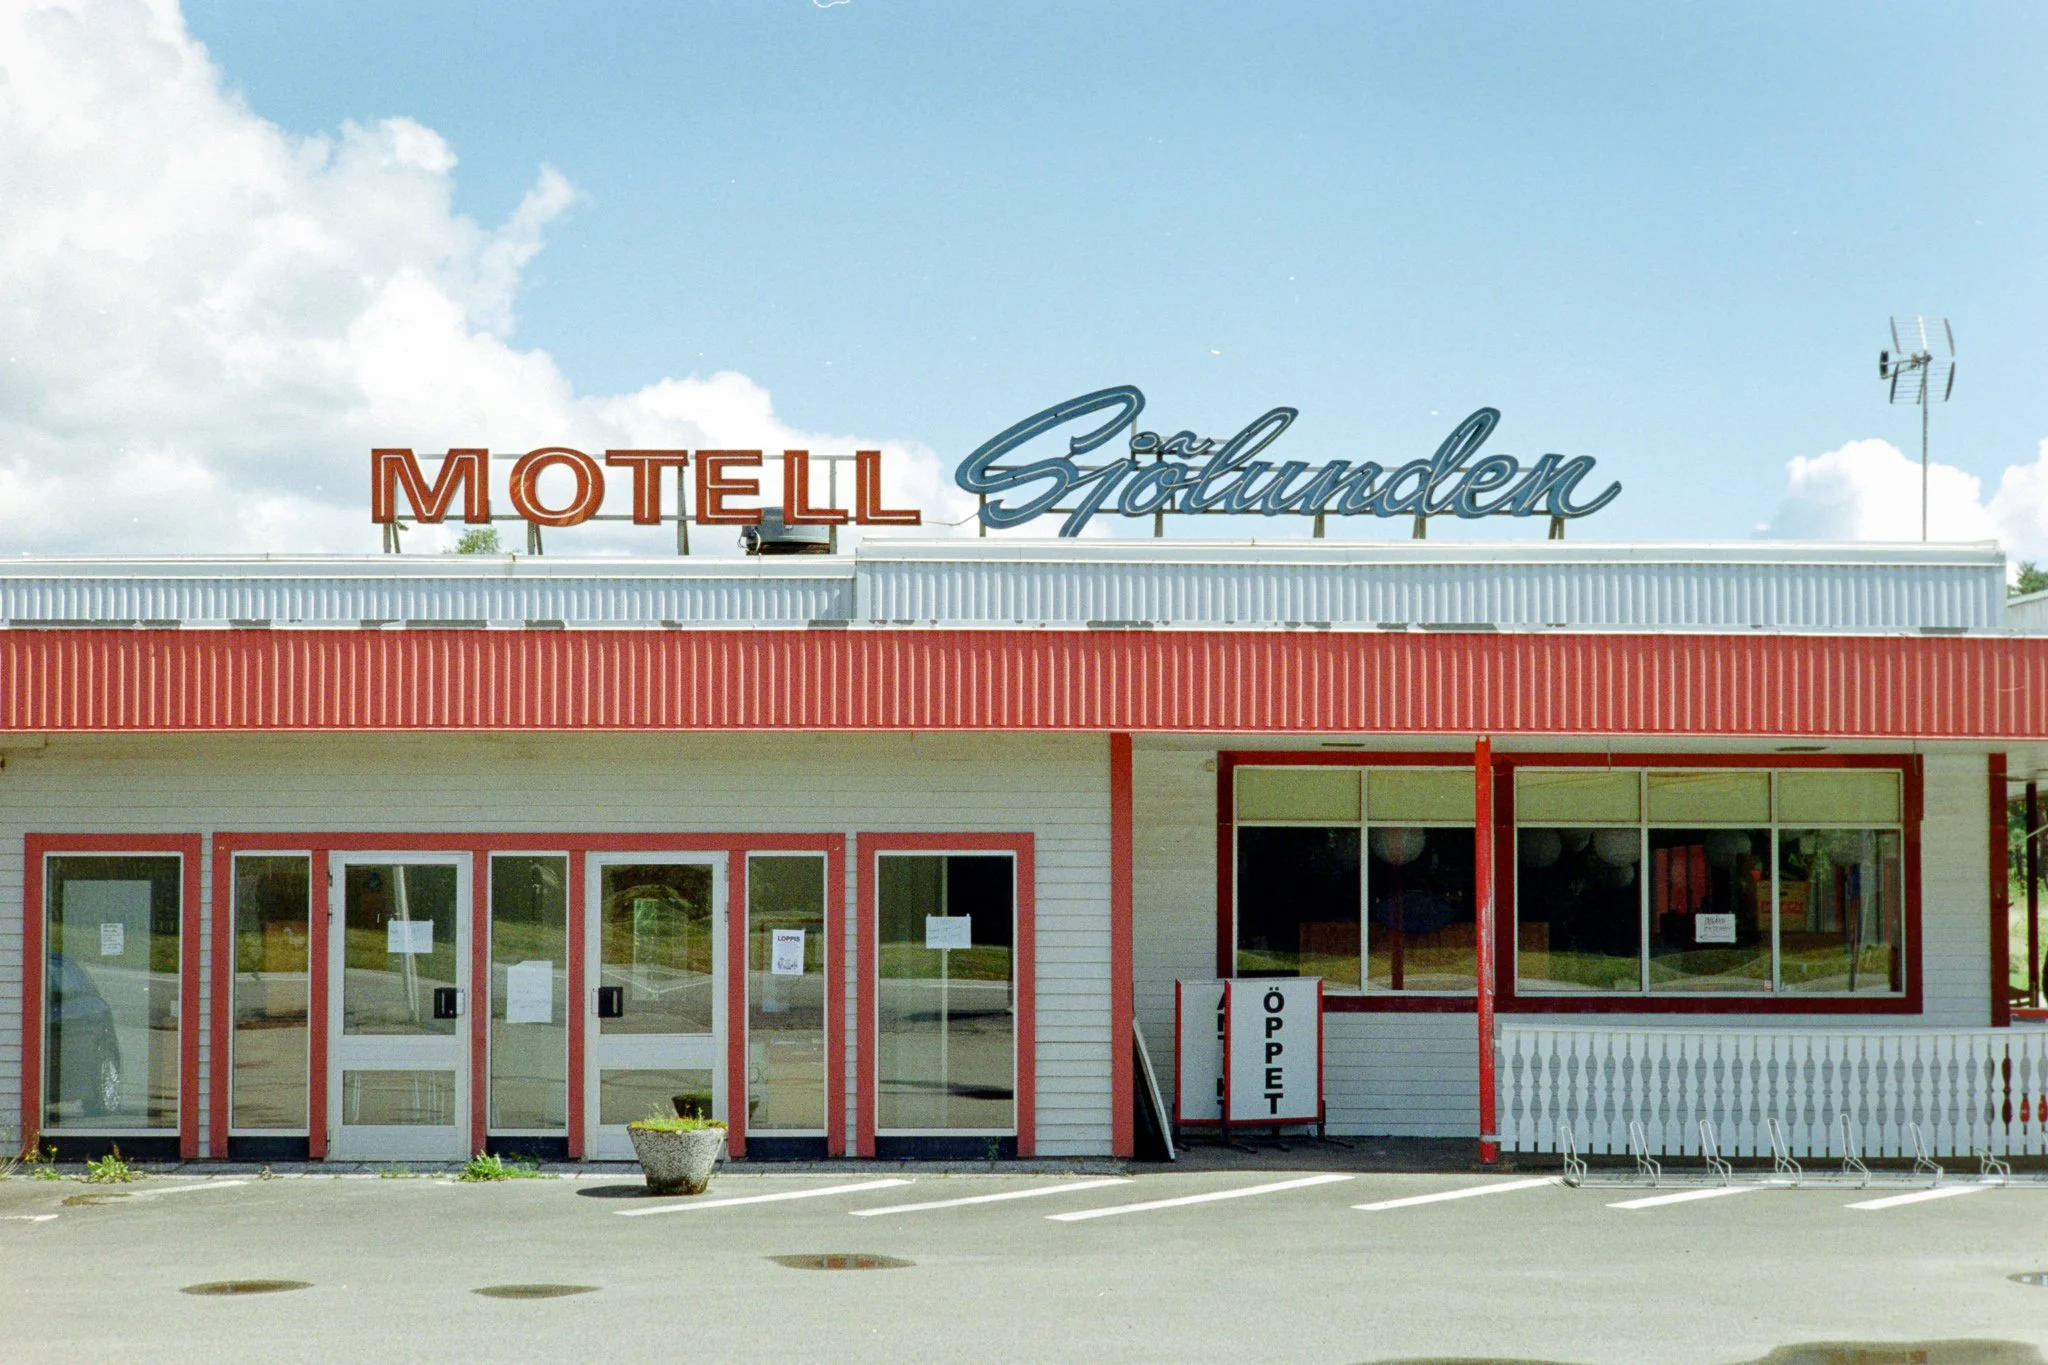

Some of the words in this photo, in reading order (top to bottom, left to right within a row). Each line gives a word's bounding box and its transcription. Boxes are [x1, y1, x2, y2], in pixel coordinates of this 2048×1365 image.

[371, 446, 922, 527] MOTELL
[955, 384, 1622, 537] Sjölunden
[1263, 986, 1285, 1115] ÖPPET
